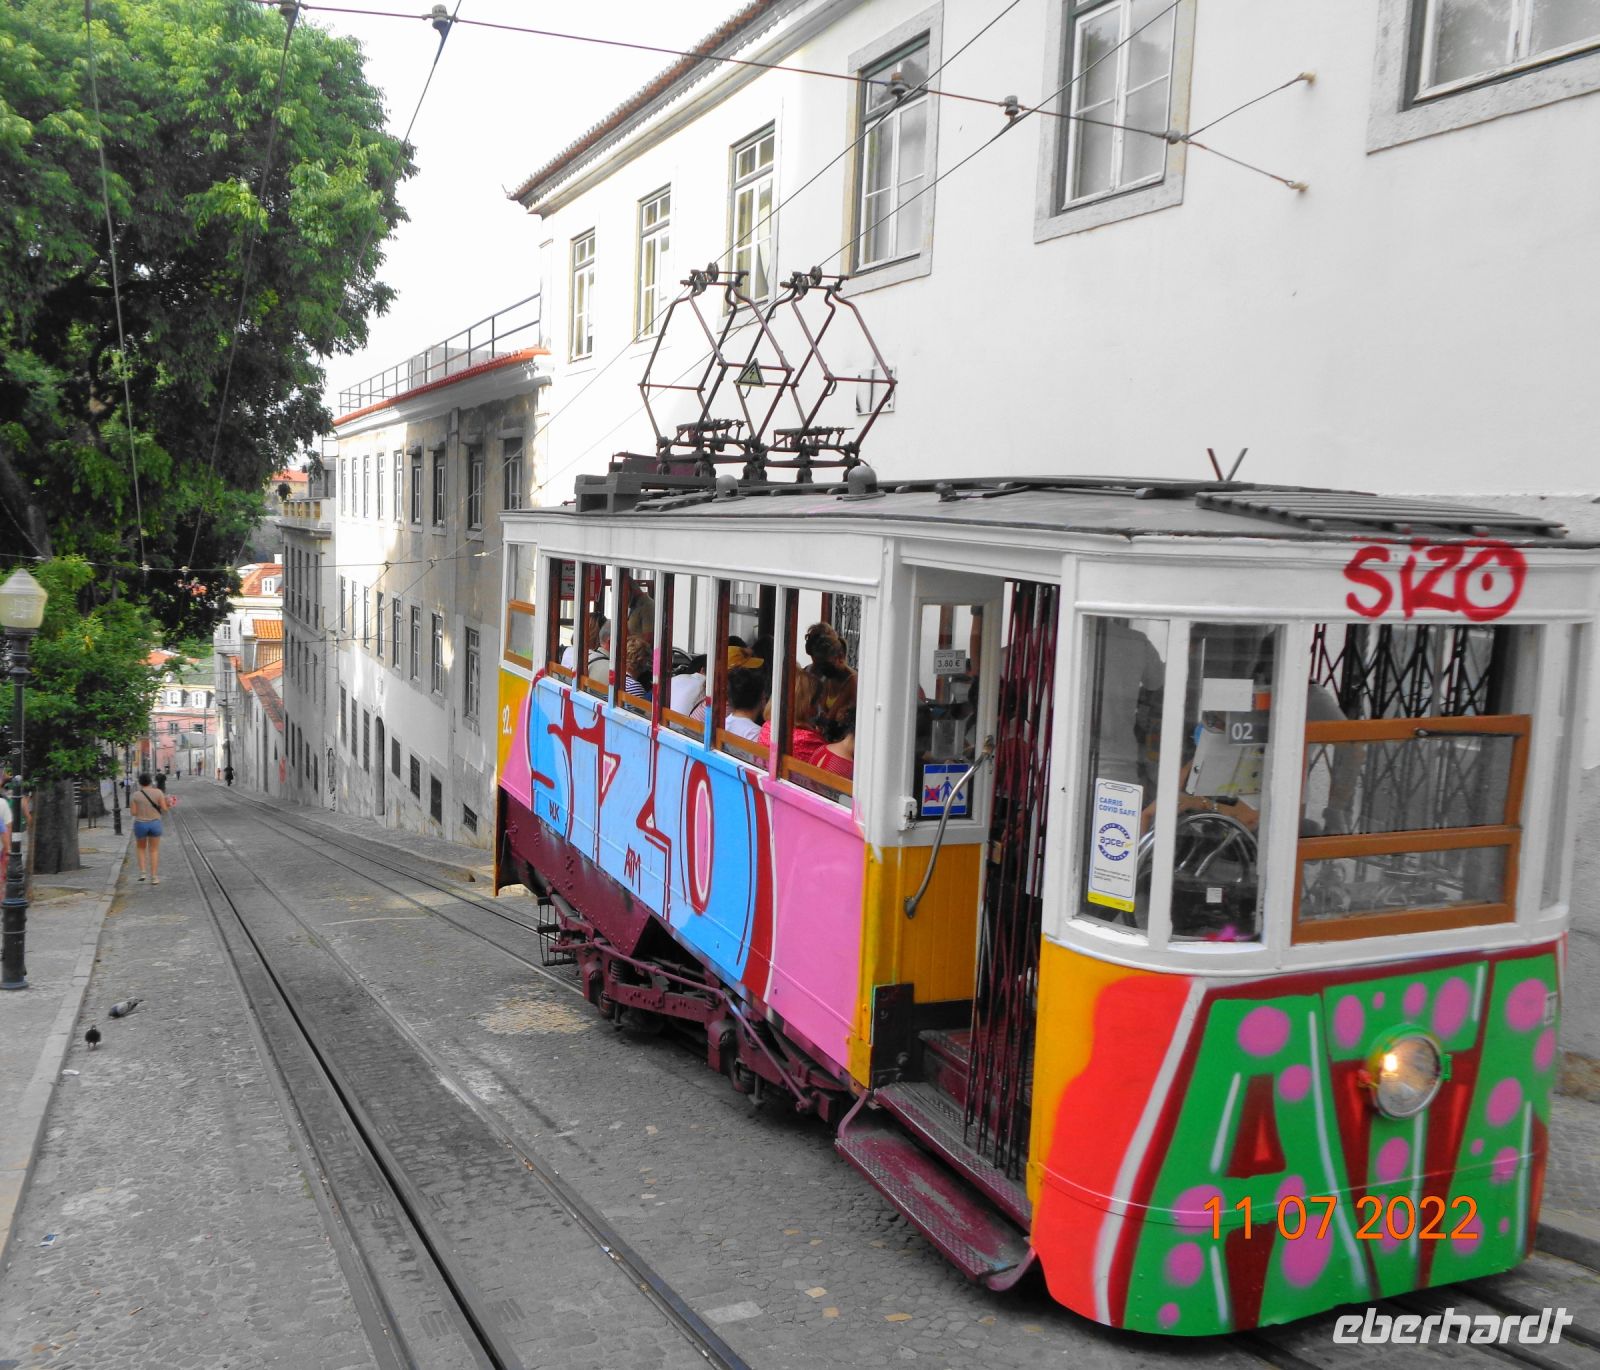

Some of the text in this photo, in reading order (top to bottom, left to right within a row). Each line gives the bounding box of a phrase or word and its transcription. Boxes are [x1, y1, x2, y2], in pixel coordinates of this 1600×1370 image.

[1231, 722, 1253, 740] 02
[1099, 797, 1123, 806] CARRIS
[1098, 804, 1118, 813] COVID
[1099, 836, 1126, 848] apcer
